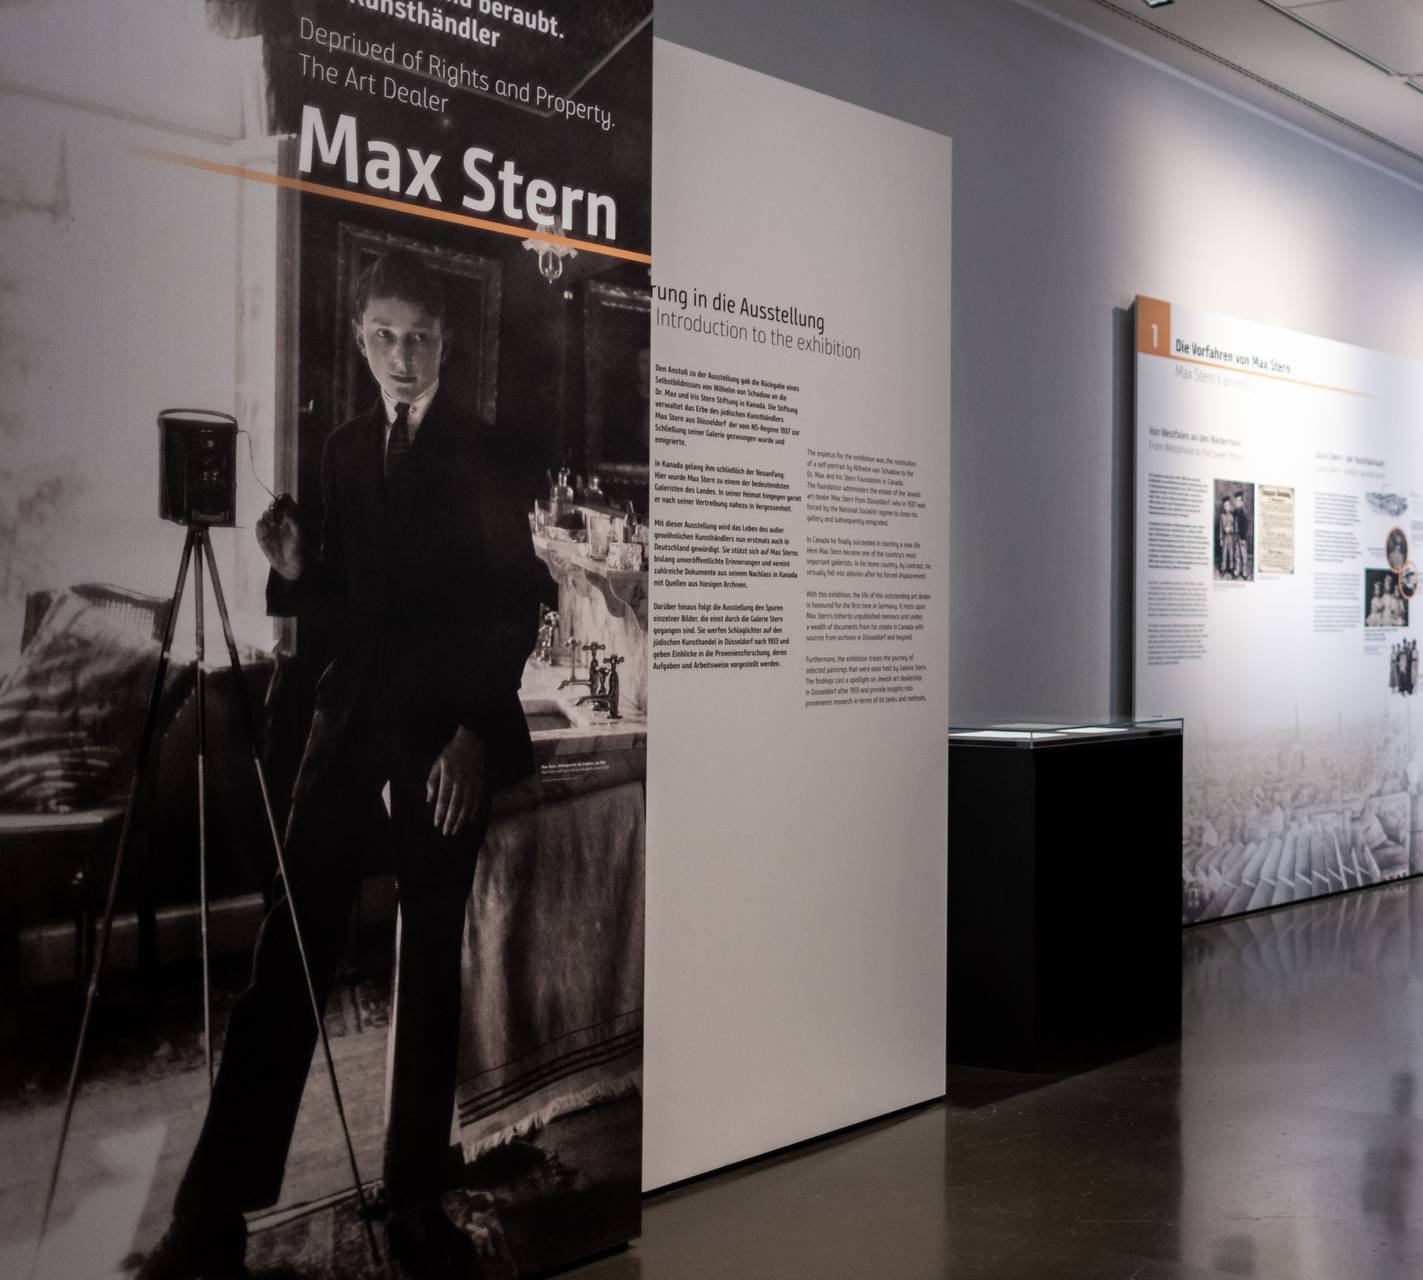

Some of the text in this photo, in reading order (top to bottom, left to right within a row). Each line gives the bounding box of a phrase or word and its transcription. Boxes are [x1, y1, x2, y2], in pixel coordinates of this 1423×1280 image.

[480, 0, 564, 38] beraubt.
[300, 17, 615, 131] Deprived of Rights and Property.
[300, 54, 448, 113] The Art Dealer
[300, 104, 616, 241] Max Stern
[656, 307, 861, 361] Introduction to the exhibition
[693, 288, 707, 309] in
[712, 292, 736, 314] die
[740, 297, 825, 335] Ausstellung
[1151, 323, 1159, 349] 1
[1176, 338, 1290, 374] Die Vorfahren von Max Stern
